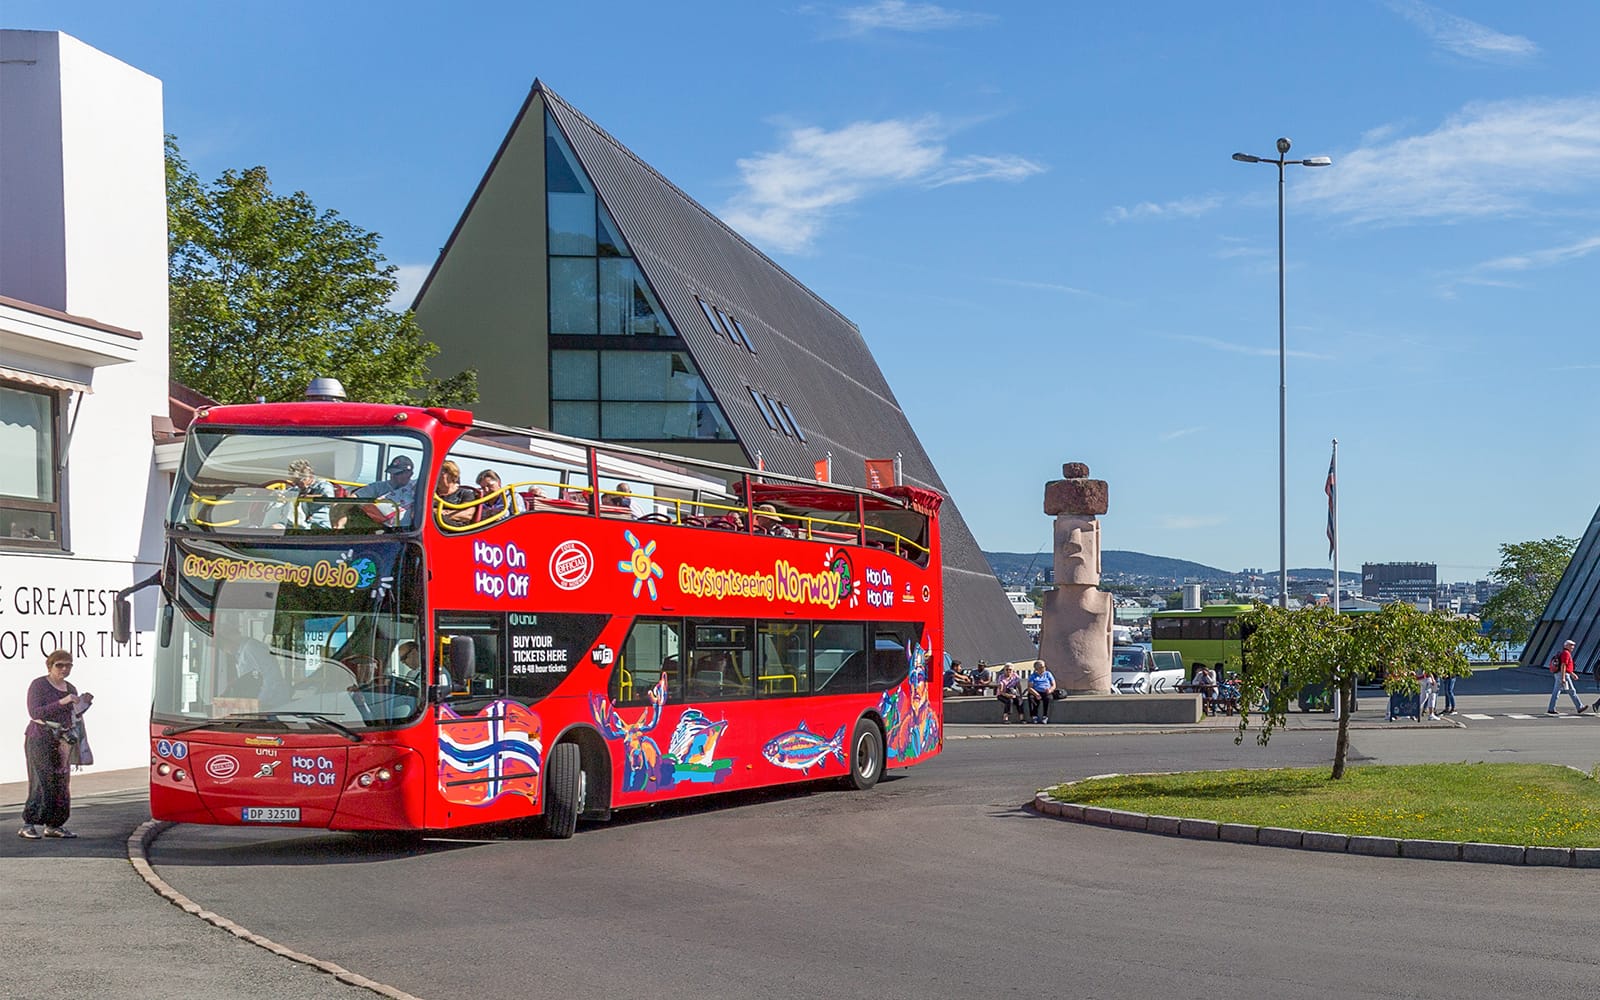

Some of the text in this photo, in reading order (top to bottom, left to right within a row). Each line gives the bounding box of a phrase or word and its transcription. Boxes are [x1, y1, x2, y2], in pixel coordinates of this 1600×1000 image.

[474, 541, 526, 568] Hop On
[313, 559, 359, 589] Oslo
[557, 556, 586, 575] OFFICIAL
[475, 572, 530, 598] Hop Off
[774, 559, 841, 609] Norway
[866, 568, 892, 586] Hop On
[14, 586, 119, 616] GREATEST
[867, 589, 882, 607] Hop
[882, 590, 894, 607] Off
[0, 630, 143, 660] OF OUR TIME
[513, 635, 553, 648] BUY YOUR
[513, 649, 567, 662] TICKETS HERE
[535, 664, 548, 673] hour
[548, 663, 567, 673] tickets
[292, 756, 333, 770] Hop On
[293, 772, 336, 786] Hop Off
[250, 809, 297, 819] DP 32510
